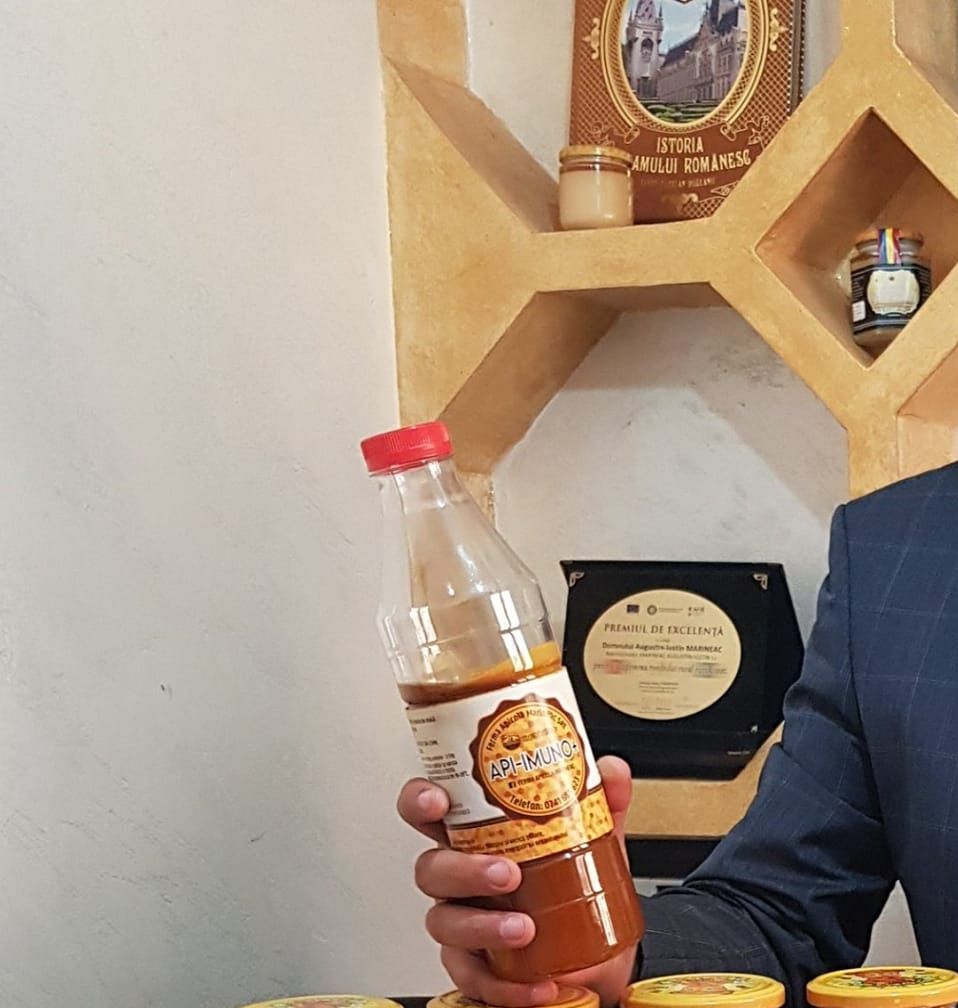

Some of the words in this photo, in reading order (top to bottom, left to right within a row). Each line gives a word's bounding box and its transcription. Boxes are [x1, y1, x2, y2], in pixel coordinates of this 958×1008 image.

[656, 137, 704, 153] ISTORIA
[604, 623, 648, 633] PREMIUL
[651, 625, 664, 634] DE
